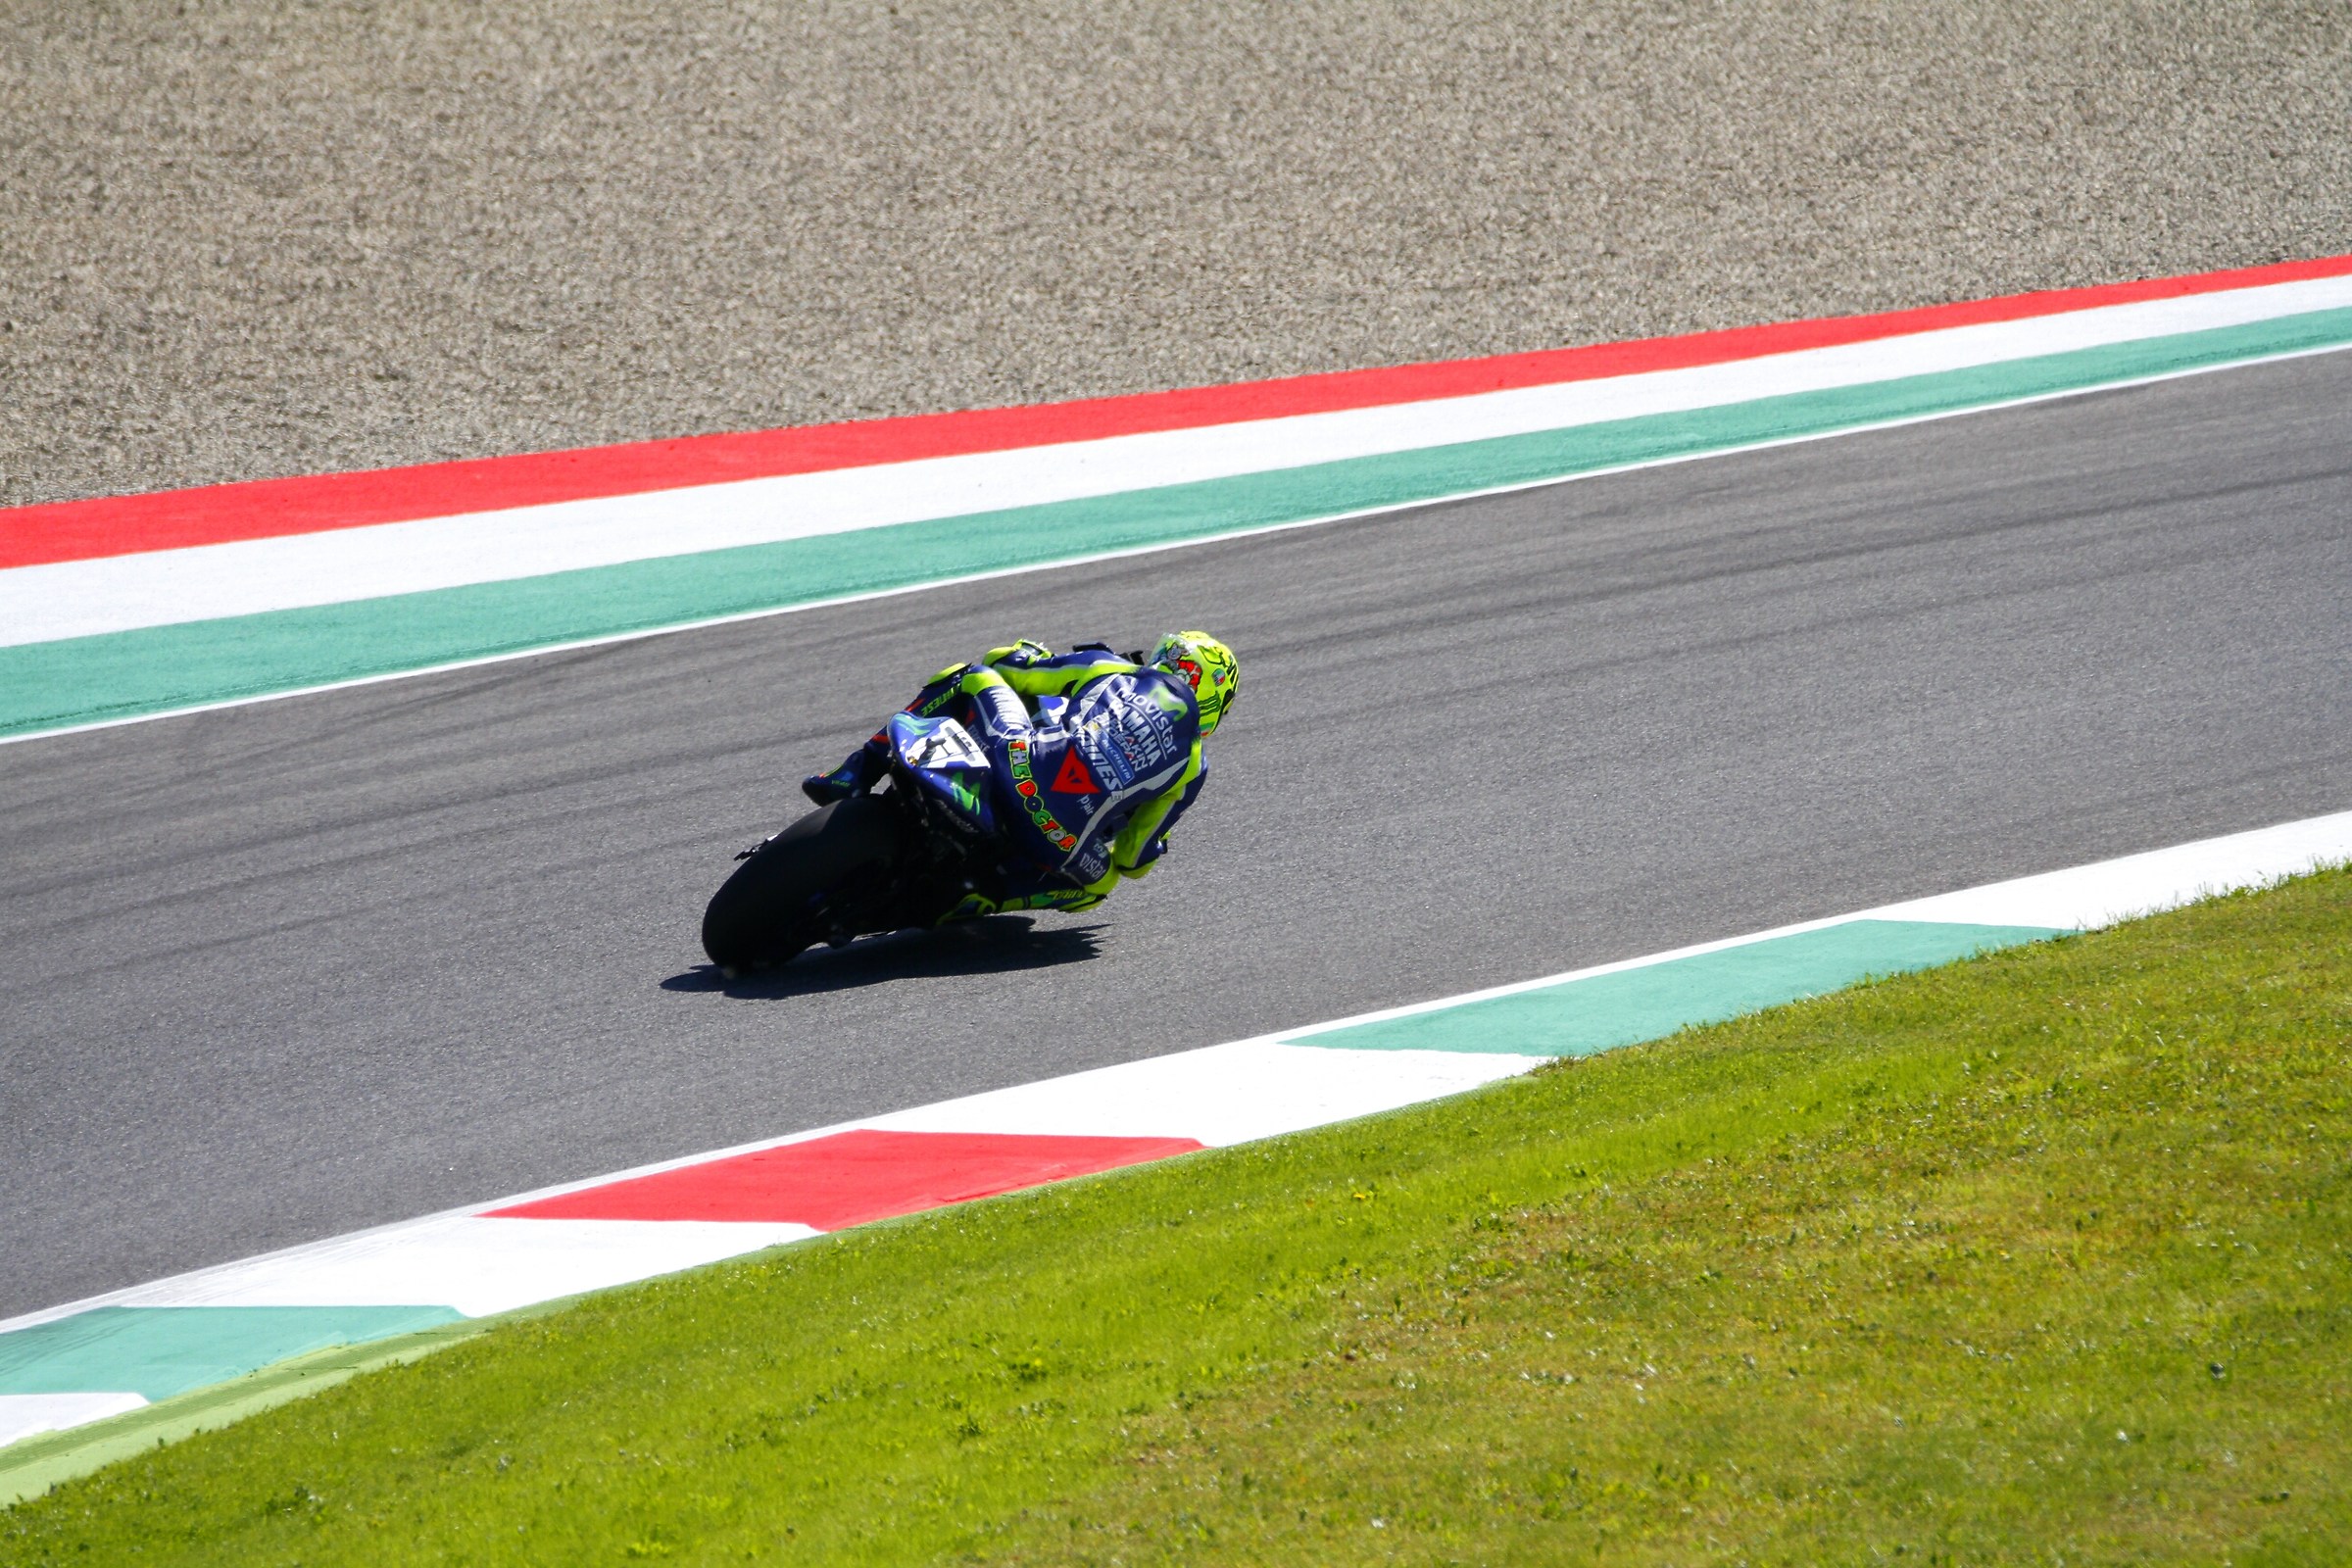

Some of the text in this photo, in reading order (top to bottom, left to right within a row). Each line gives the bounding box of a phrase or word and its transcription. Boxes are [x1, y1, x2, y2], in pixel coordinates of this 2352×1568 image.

[1008, 740, 1032, 778] THE
[1102, 738, 1132, 779] MICHELIN
[1108, 699, 1161, 766] YAMAHA
[1015, 779, 1078, 852] DOCTOR
